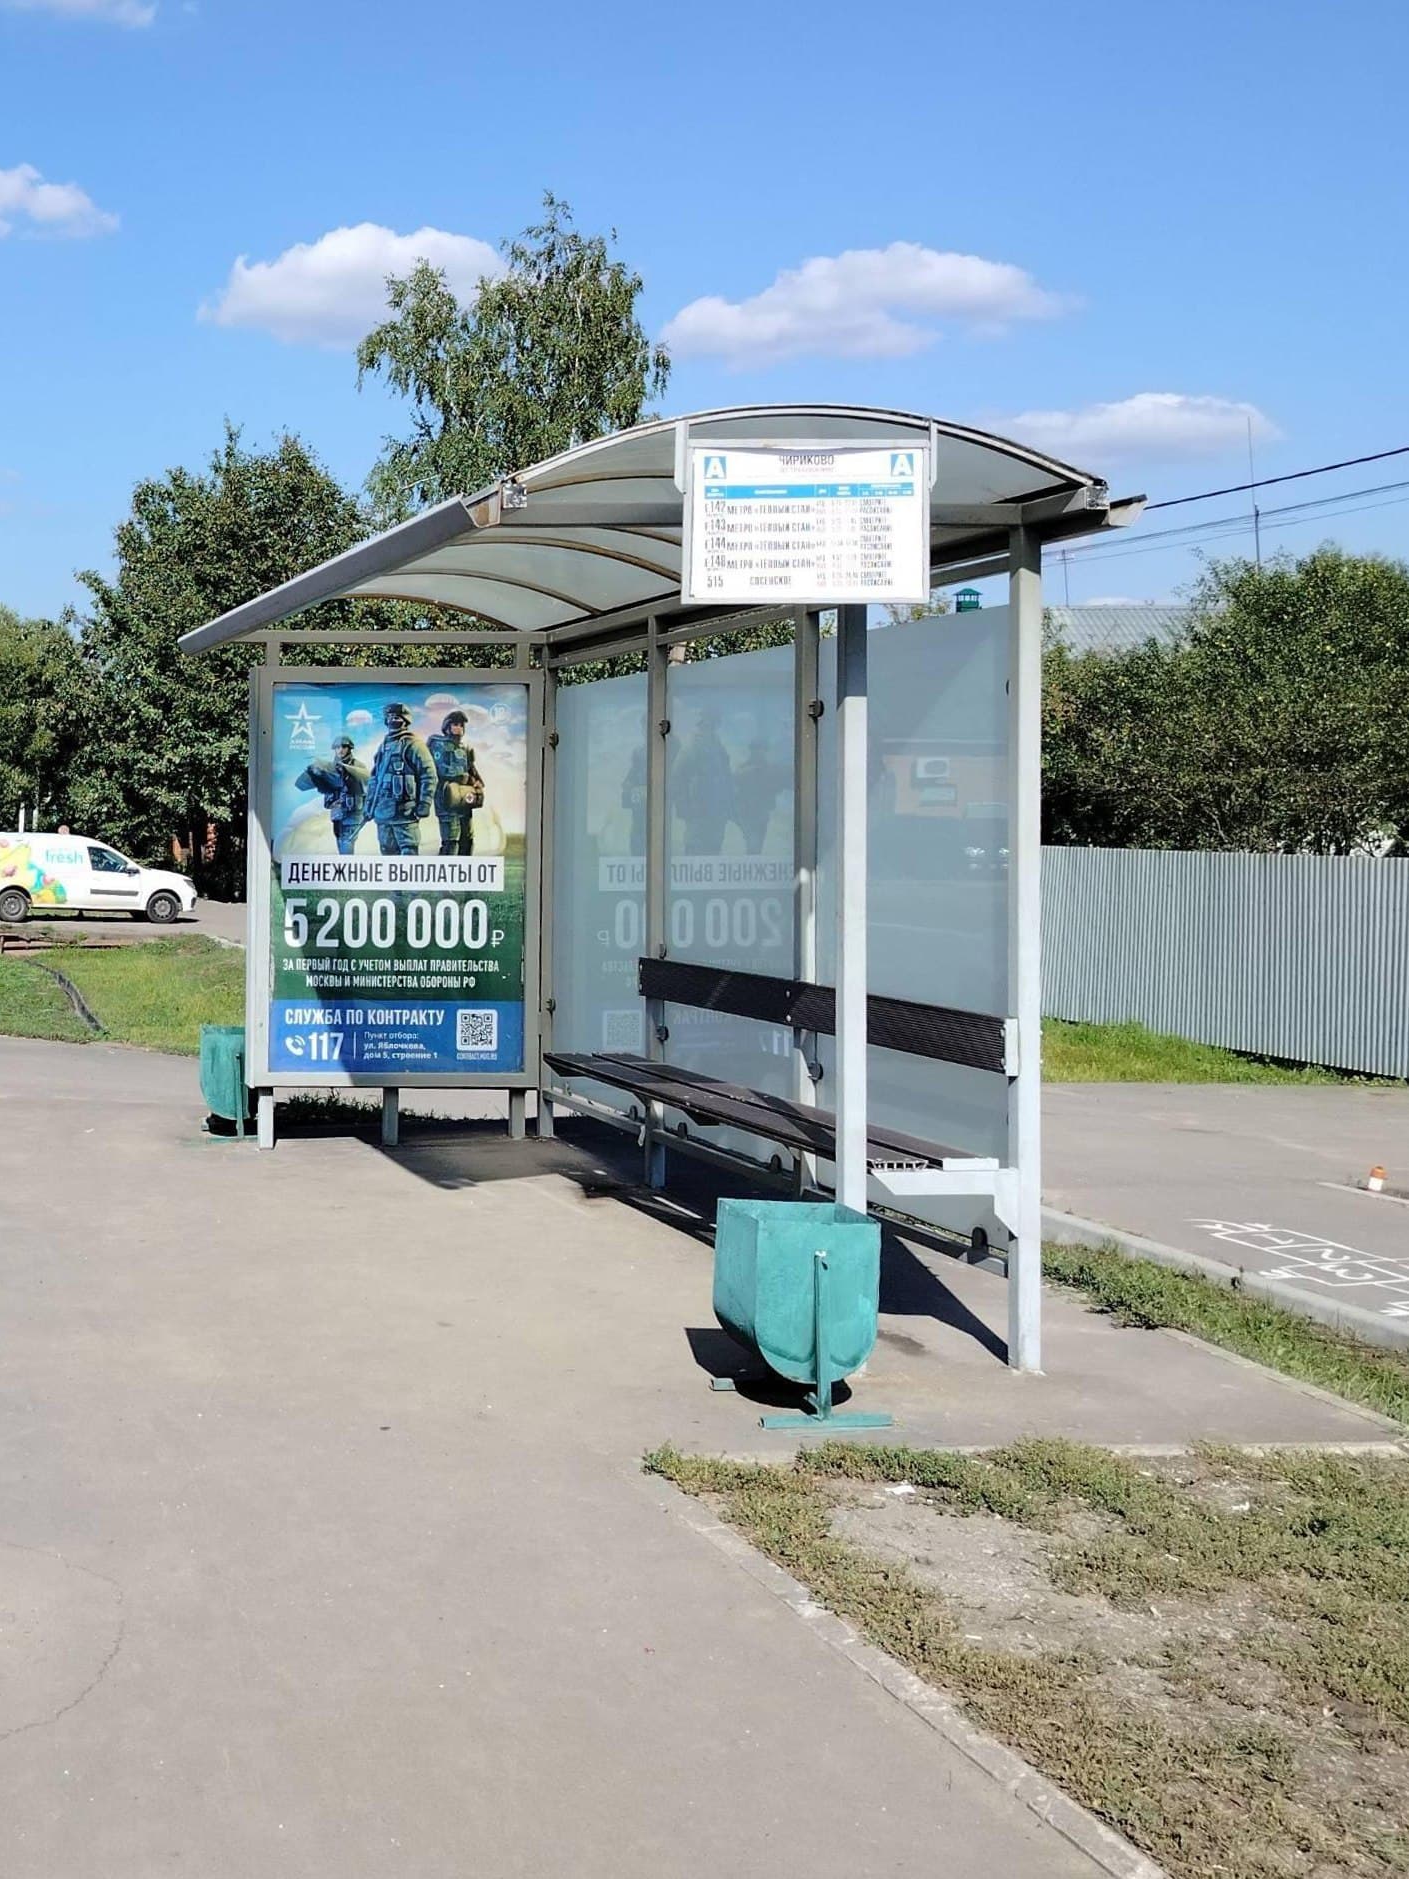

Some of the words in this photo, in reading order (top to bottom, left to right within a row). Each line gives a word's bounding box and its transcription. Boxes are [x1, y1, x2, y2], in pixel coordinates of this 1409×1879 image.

[778, 455, 834, 465] ЧИРИКОВО
[707, 576, 724, 588] 515
[45, 849, 84, 864] fresh
[288, 862, 383, 883] ДЕНЕЖНЫЕ
[389, 863, 472, 883] ВЫПЛАТЫ
[477, 864, 497, 883] ОТ
[284, 898, 308, 948] 5
[316, 898, 396, 949] 200
[283, 959, 294, 971] ЗА
[296, 957, 330, 971] ПЕРВЫЙ
[333, 959, 349, 972] ГОД
[351, 959, 357, 971] С
[359, 959, 391, 971] УЧЕТОМ
[394, 960, 428, 972] ВЫПЛАТ
[430, 960, 500, 972] ПРАВИТЕЛЬСТВА
[306, 975, 342, 987] МОСКВЫ
[345, 975, 351, 987] И
[353, 975, 419, 988] МИНИСТЕРСТВА
[420, 975, 461, 988] ОБОРОНЫ
[463, 976, 476, 988] РФ
[285, 1008, 342, 1025] СЛУЖБА
[346, 1008, 364, 1025] ПО
[367, 1009, 445, 1026] КОНТРАКТУ
[308, 1032, 344, 1060] 117
